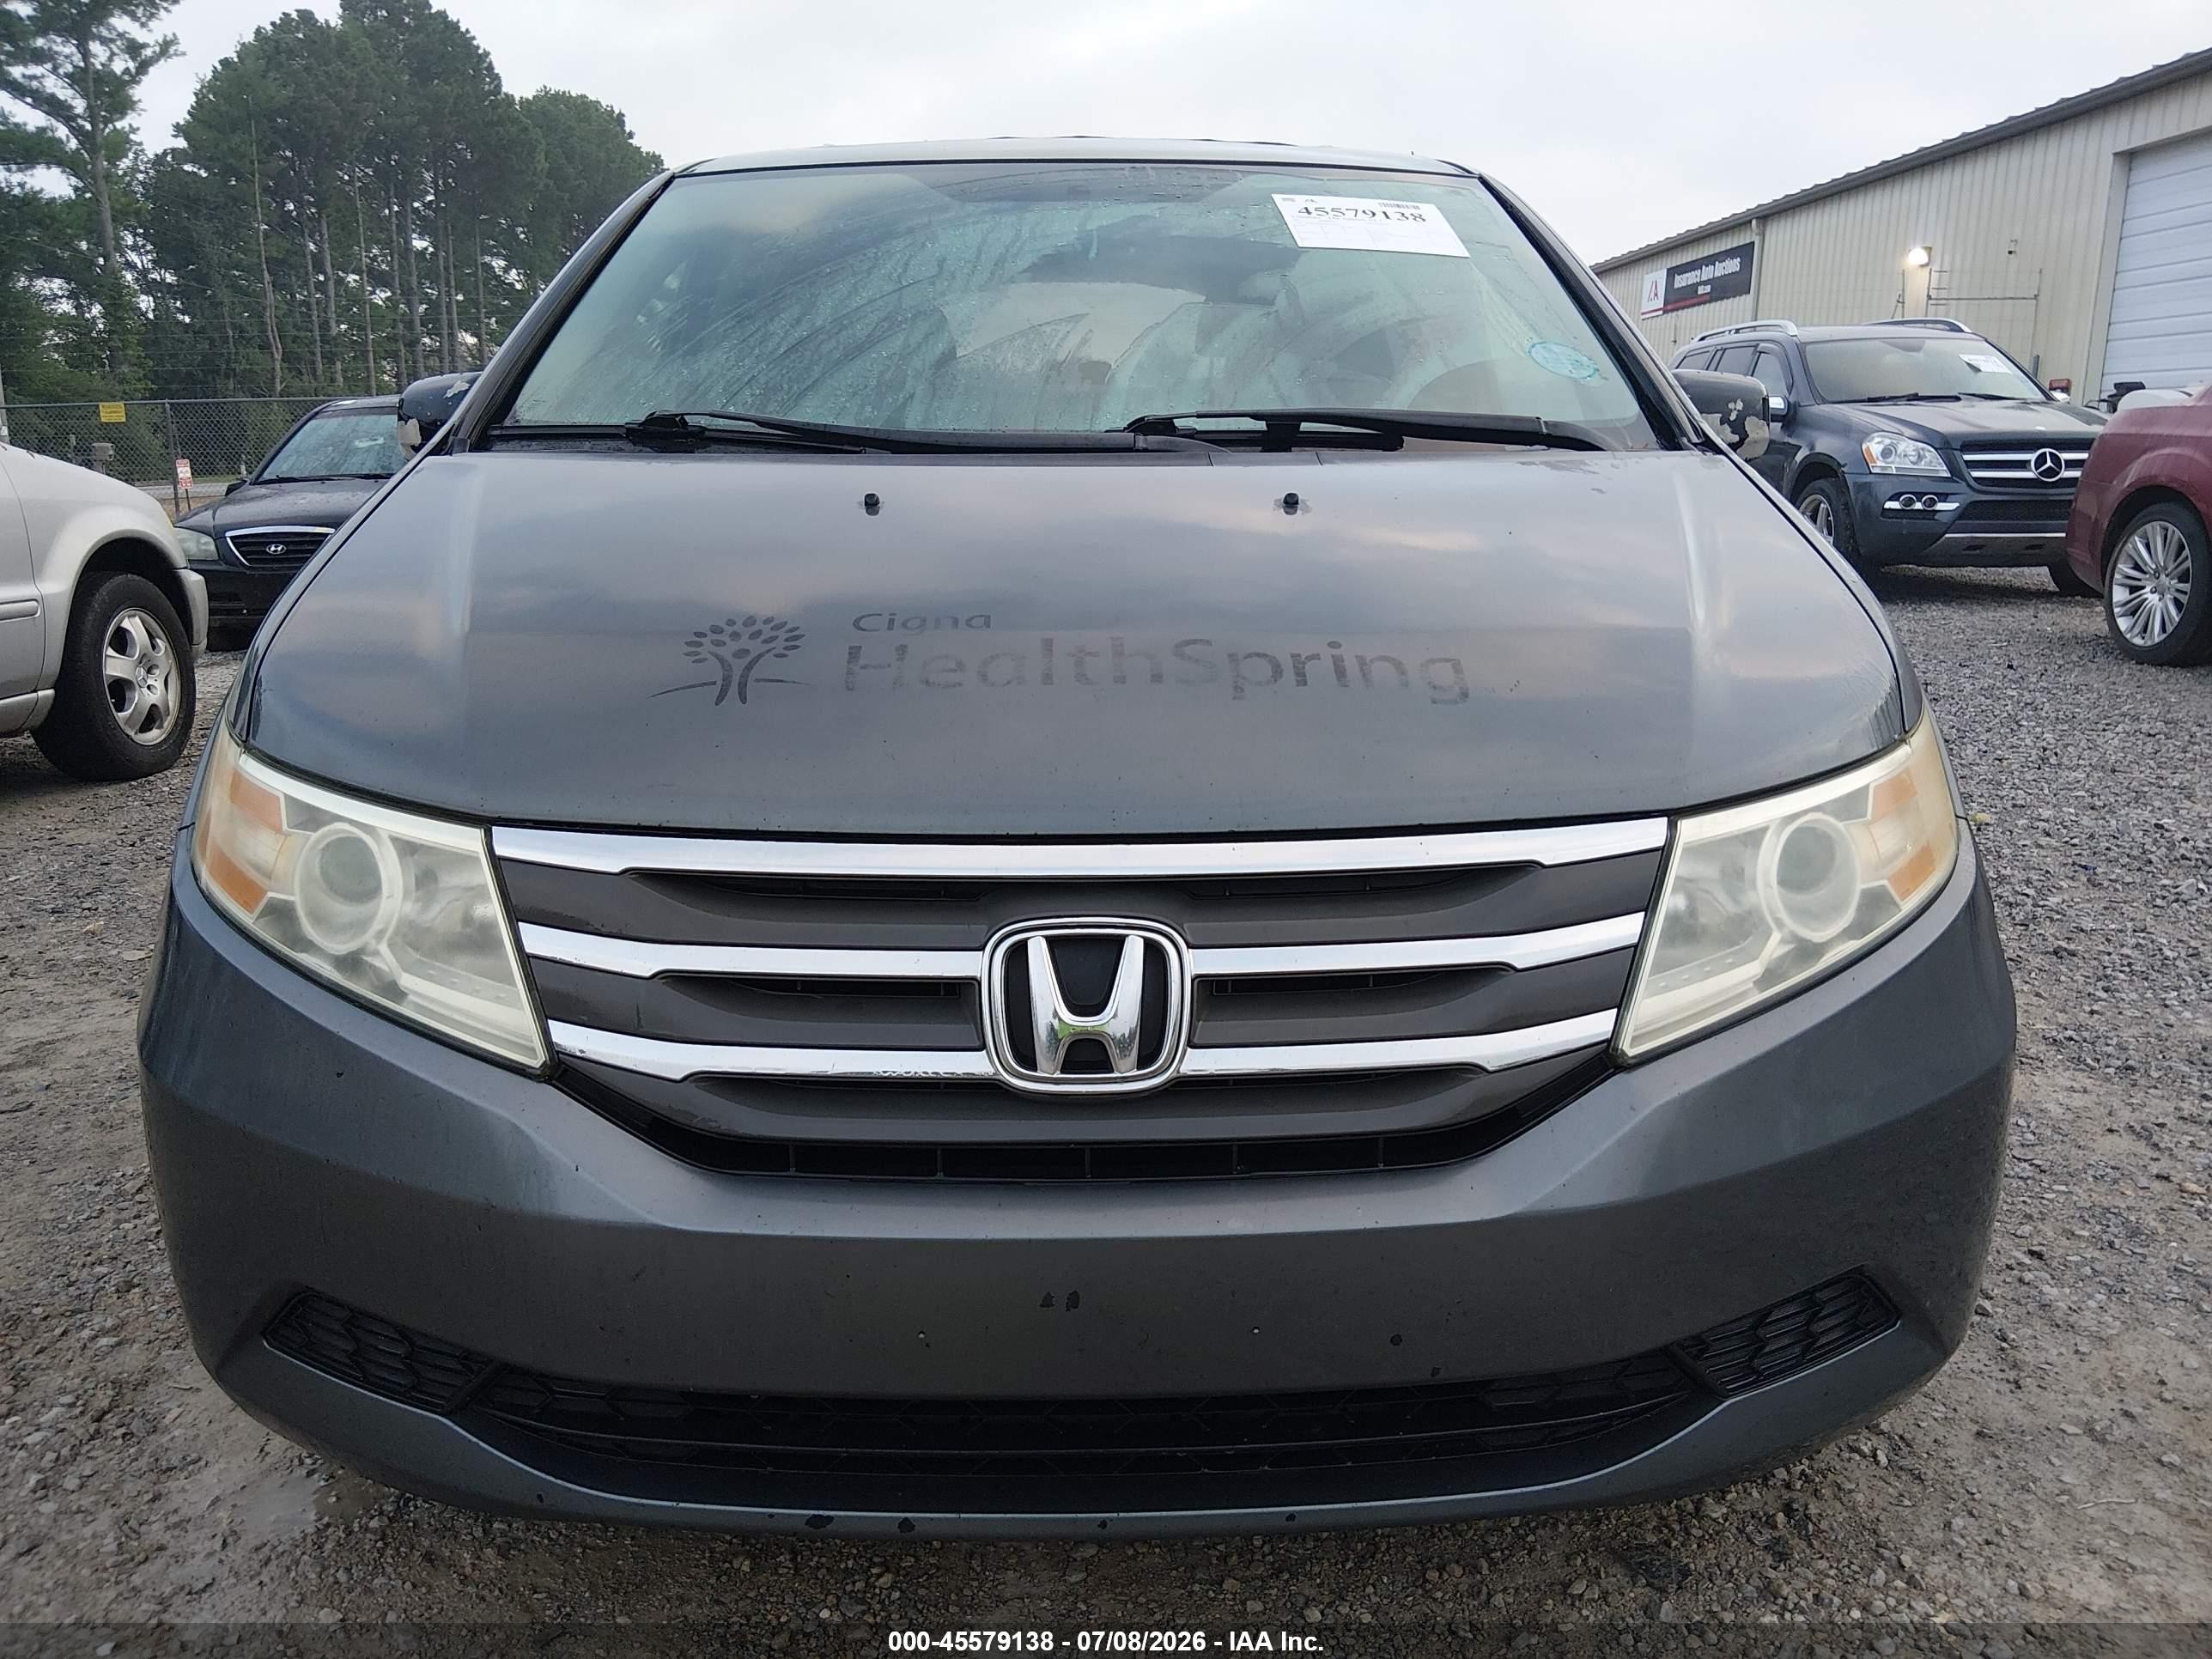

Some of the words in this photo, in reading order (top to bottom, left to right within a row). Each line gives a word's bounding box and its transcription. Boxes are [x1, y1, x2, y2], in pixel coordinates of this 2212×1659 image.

[1297, 206, 1426, 222] 45579138
[852, 612, 993, 635] Cigna
[844, 635, 1470, 705] HealthSpring
